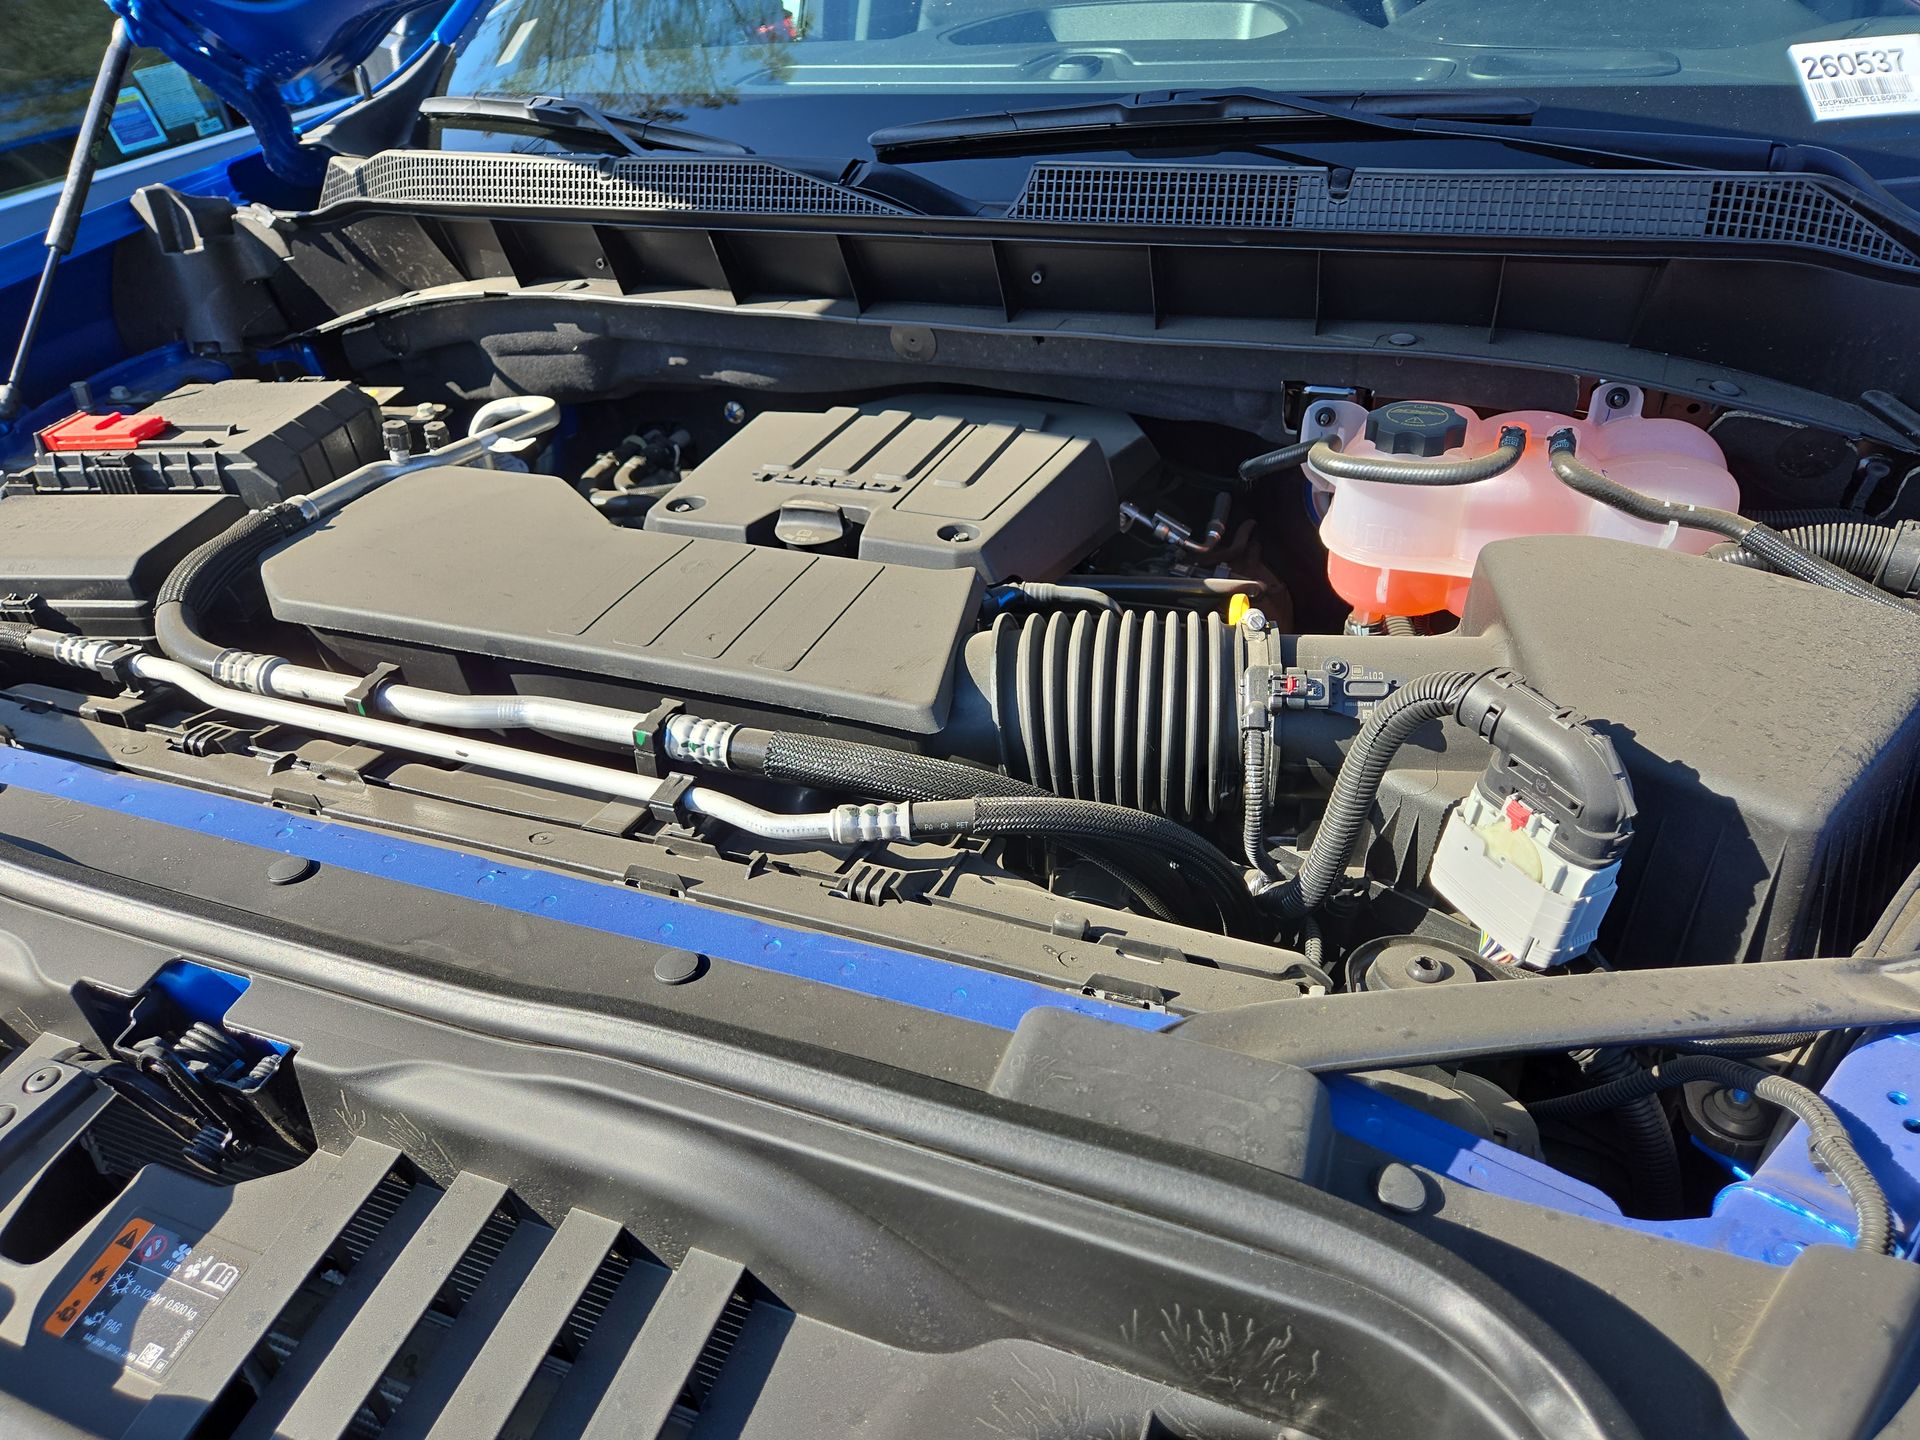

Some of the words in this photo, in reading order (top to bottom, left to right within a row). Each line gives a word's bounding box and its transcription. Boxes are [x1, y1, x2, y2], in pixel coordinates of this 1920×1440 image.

[1801, 48, 1904, 80] 260537
[956, 821, 969, 829] PET
[161, 1259, 181, 1273] AUTO
[130, 1284, 168, 1306] R-1234yf
[164, 1299, 189, 1315] 0.600
[184, 1307, 199, 1321] kg
[104, 1318, 123, 1334] PAG
